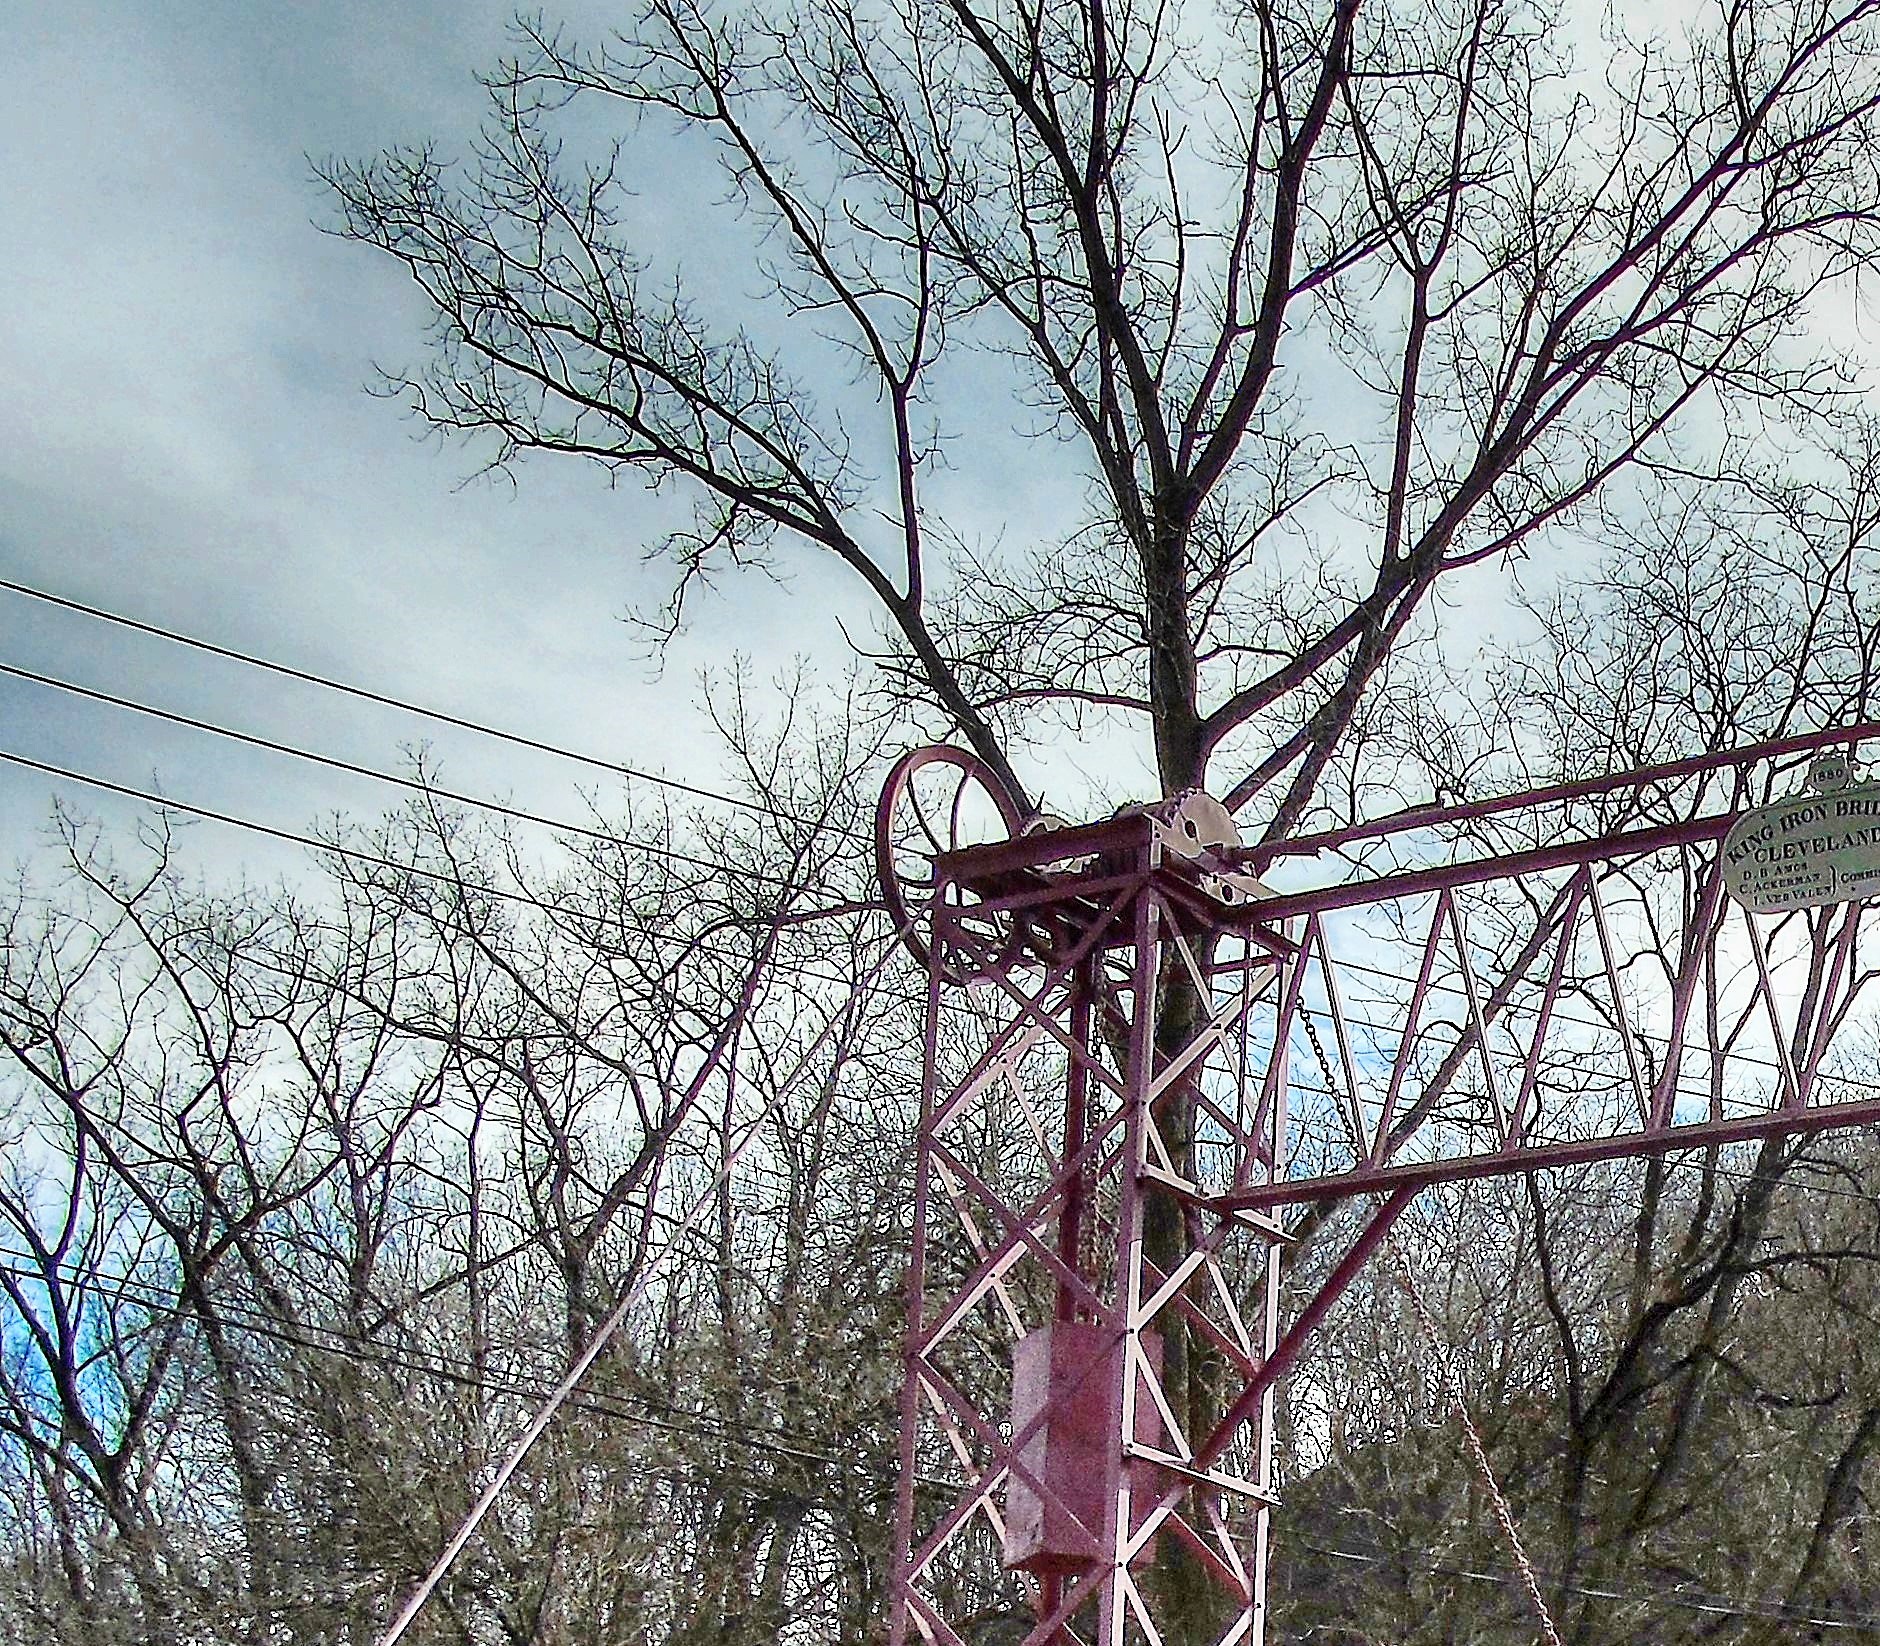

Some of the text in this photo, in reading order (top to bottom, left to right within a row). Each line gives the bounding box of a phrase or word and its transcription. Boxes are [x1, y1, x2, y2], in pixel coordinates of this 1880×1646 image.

[1813, 769, 1843, 782] 1880
[1727, 825, 1774, 866] KING
[1780, 803, 1826, 832] IRON
